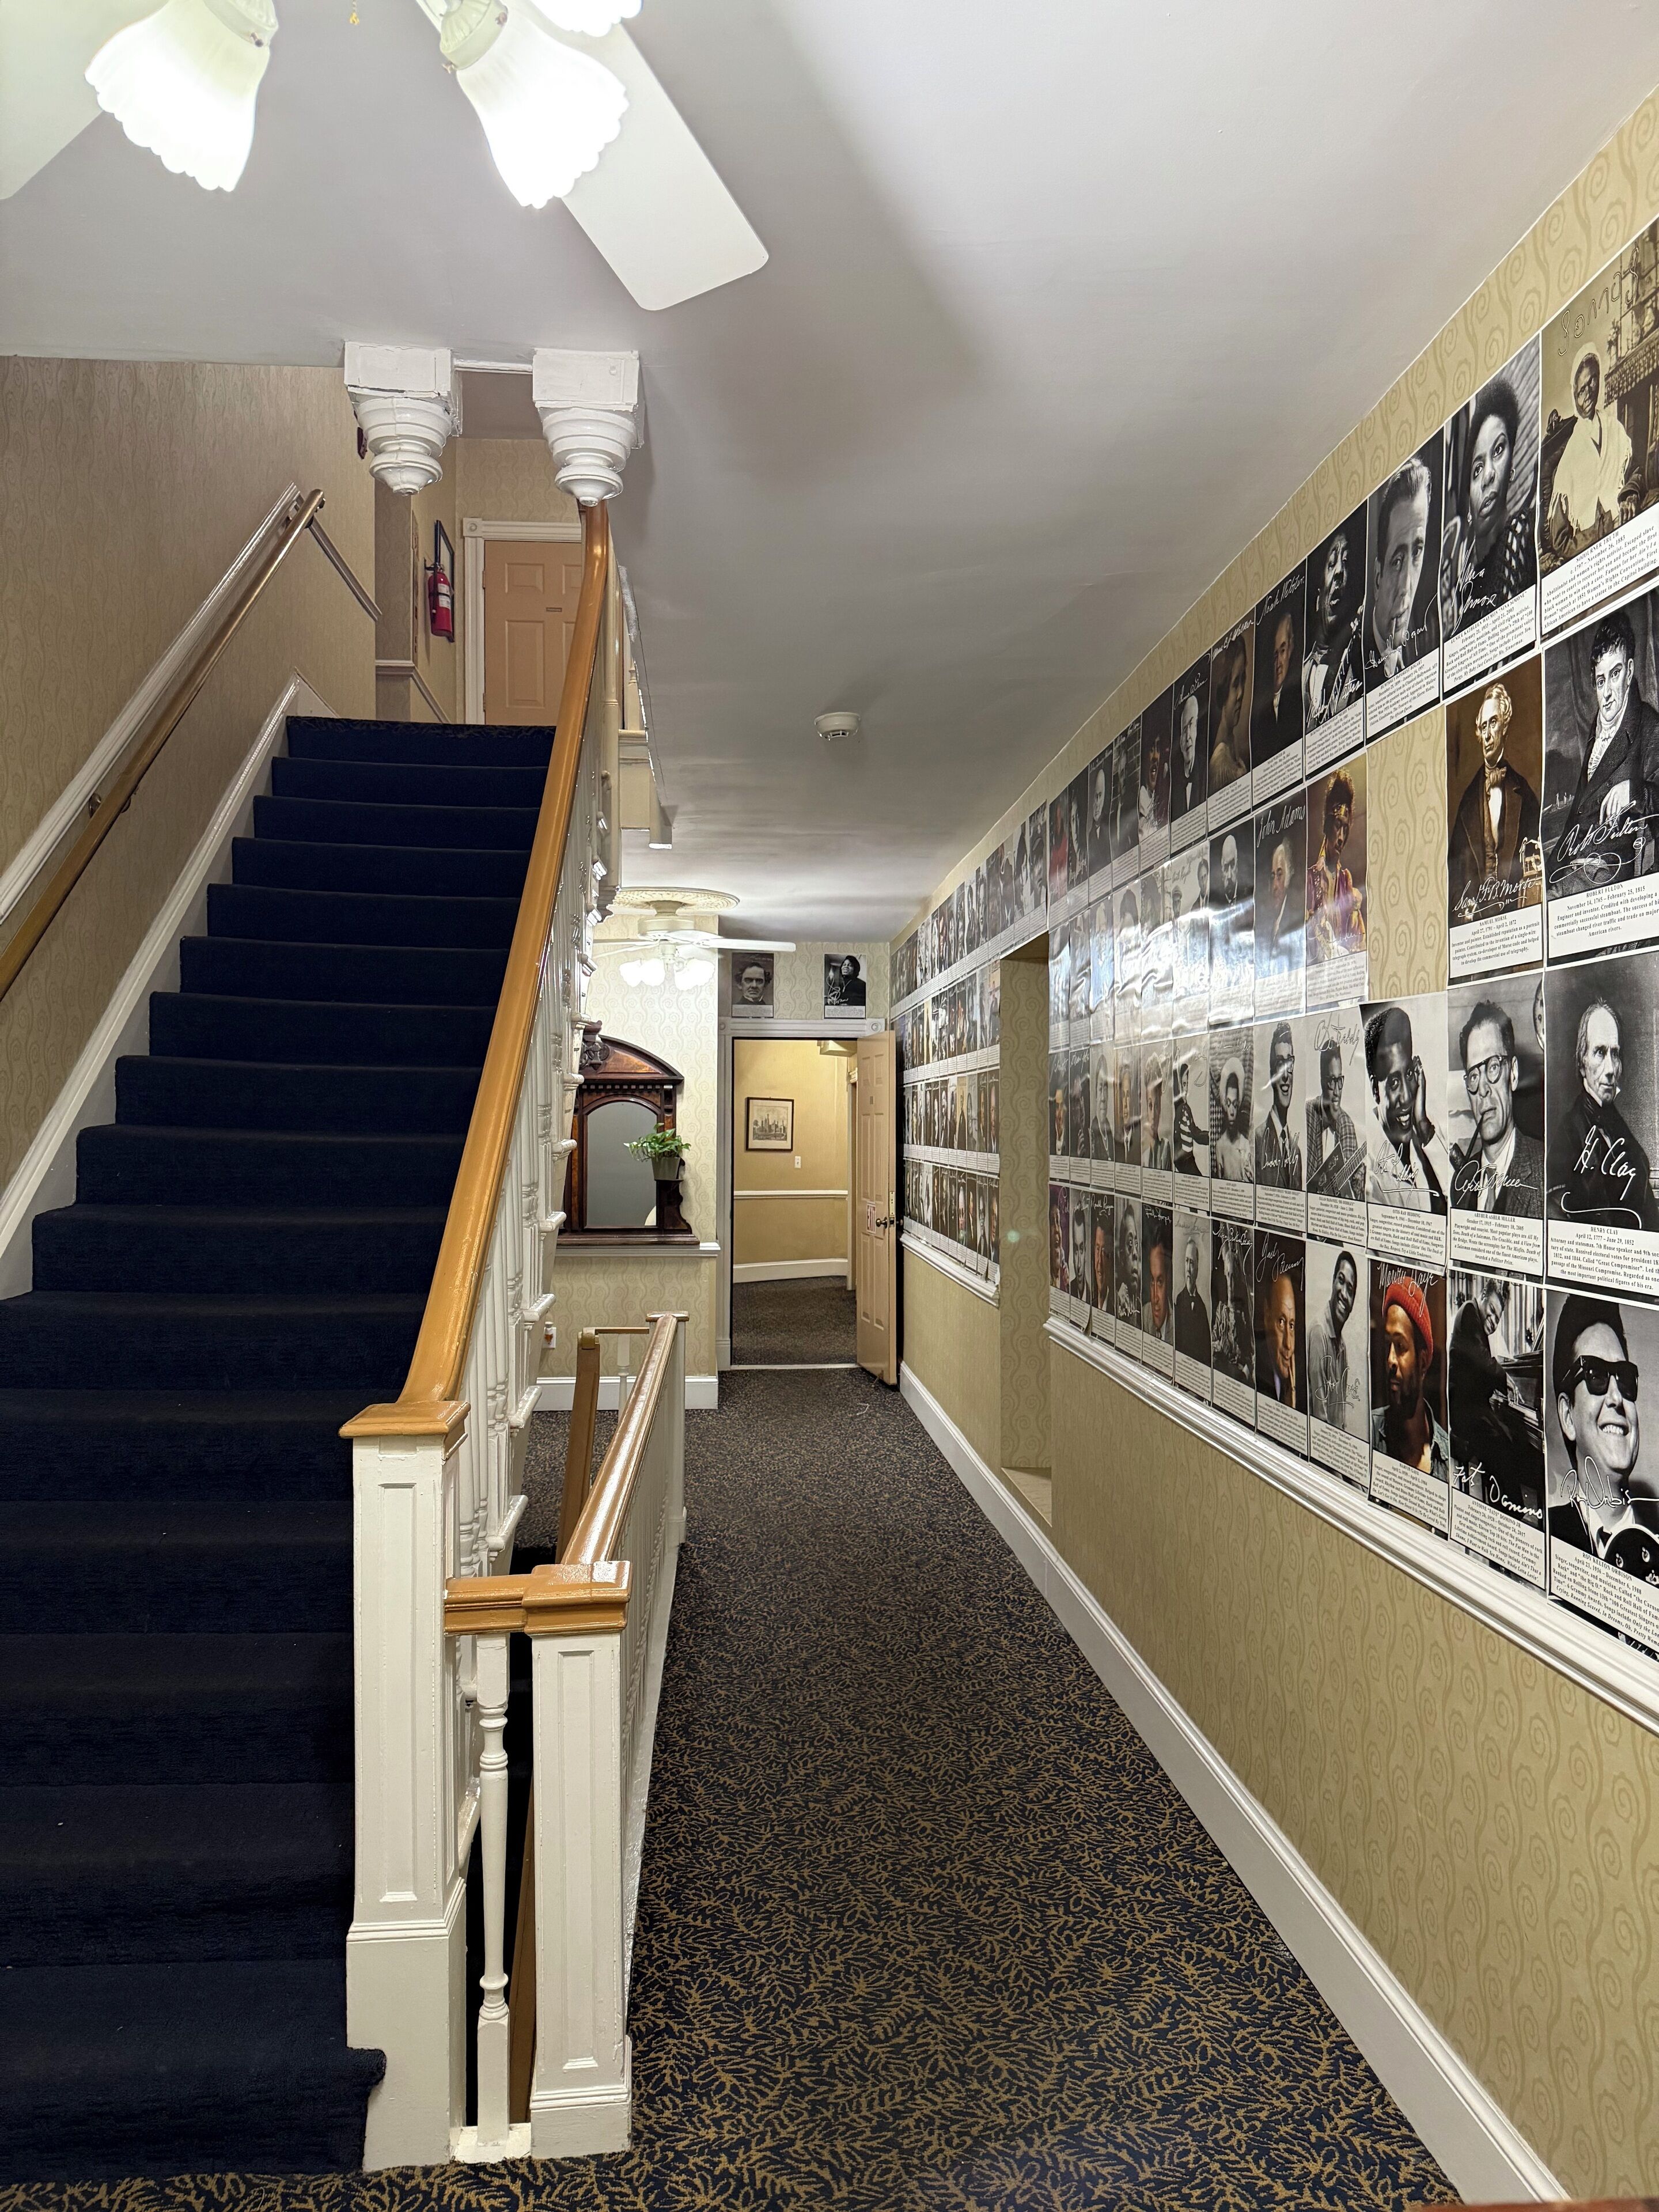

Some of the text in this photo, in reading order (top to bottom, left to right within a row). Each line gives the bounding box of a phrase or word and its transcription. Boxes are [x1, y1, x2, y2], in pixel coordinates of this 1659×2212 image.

[1257, 805, 1305, 847] John Adams
[1586, 884, 1623, 898] ROBERT FULTON
[1557, 913, 1573, 921] Engineer
[1601, 901, 1619, 910] Credited
[1630, 893, 1653, 903] developing
[1567, 902, 1586, 911] November
[1607, 892, 1626, 900] February
[1554, 919, 1578, 929] commercially
[1580, 914, 1599, 923] successful
[1556, 928, 1575, 936] steamboat
[1575, 923, 1592, 931] changed
[1601, 1138, 1636, 1200] Clay
